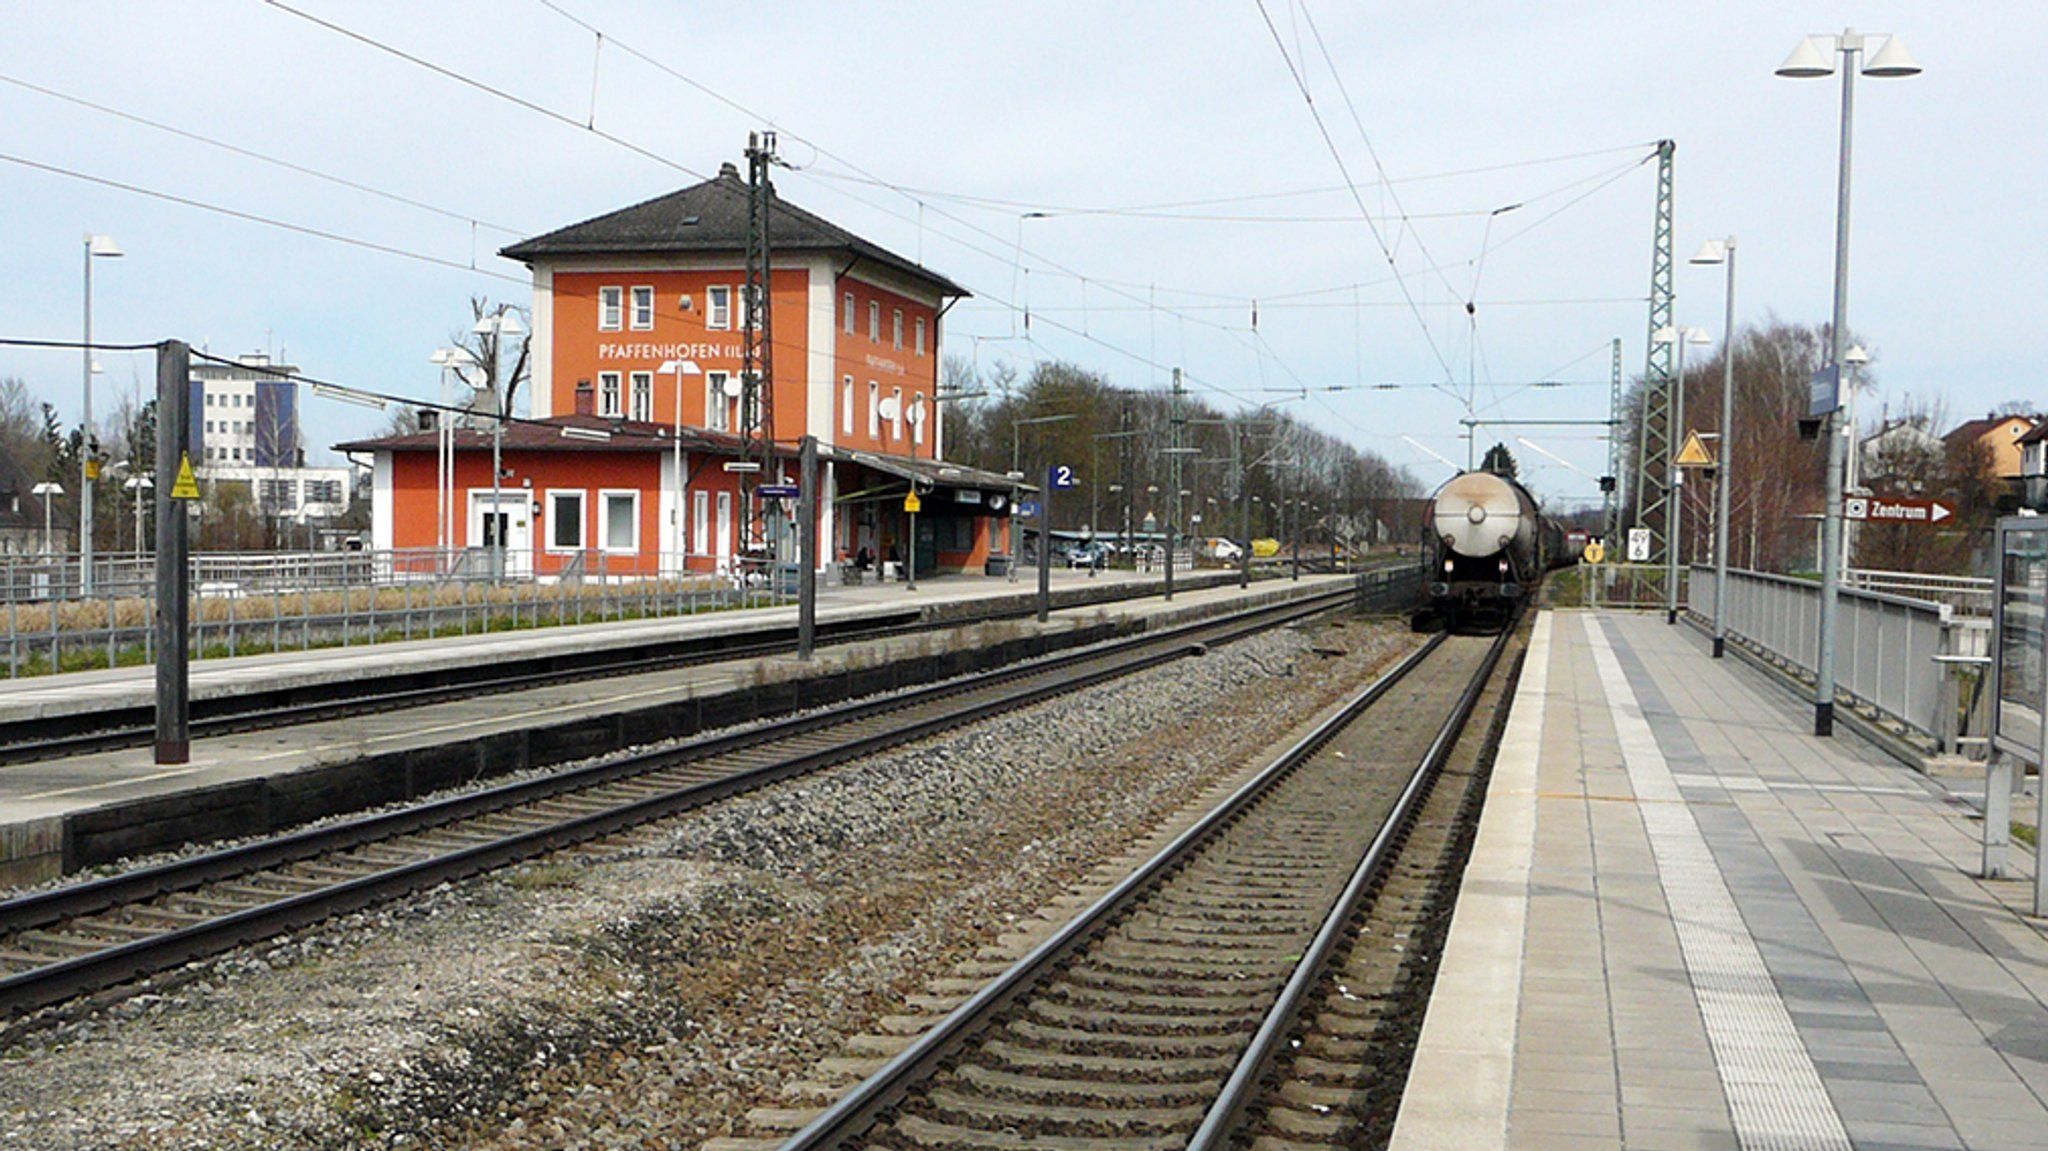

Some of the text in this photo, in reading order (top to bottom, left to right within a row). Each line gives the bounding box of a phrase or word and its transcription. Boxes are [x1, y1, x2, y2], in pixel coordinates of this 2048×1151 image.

[599, 343, 761, 359] PFAFFENHOFEN (IL)
[1057, 465, 1071, 485] 2
[1871, 501, 1926, 519] Zentrum
